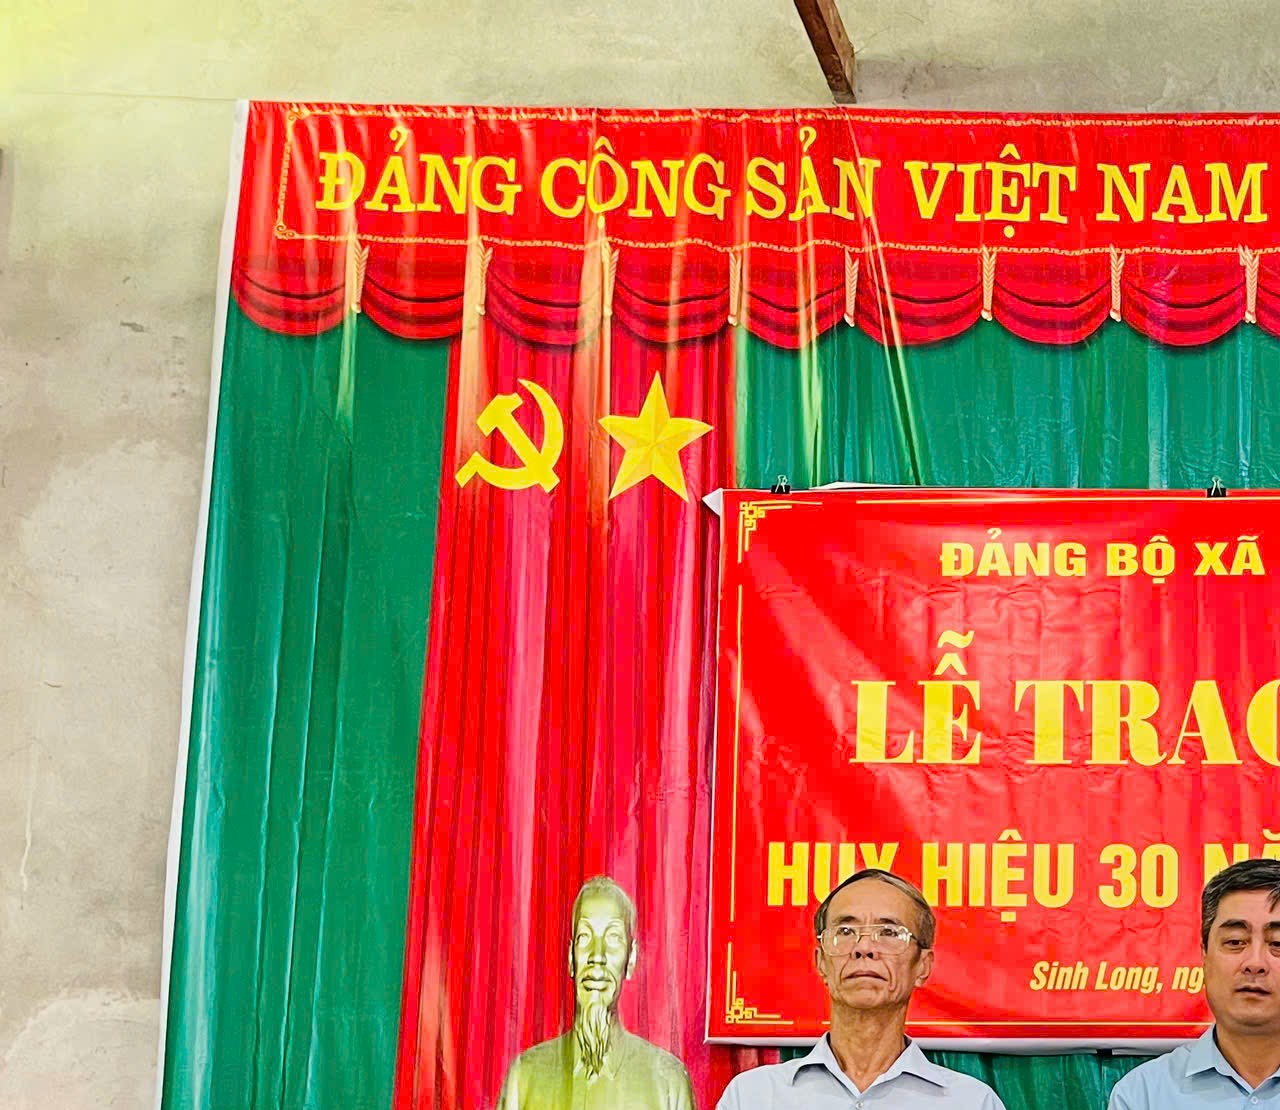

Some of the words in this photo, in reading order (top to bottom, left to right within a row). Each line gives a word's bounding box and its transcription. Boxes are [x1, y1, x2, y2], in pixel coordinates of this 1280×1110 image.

[316, 126, 522, 216] ĐẢNG
[541, 136, 731, 228] CỘNG
[746, 126, 881, 221] SẢN
[904, 144, 1076, 238] VIỆT
[1096, 162, 1268, 224] NAM
[940, 528, 1087, 577] ĐẢNG
[1106, 535, 1175, 584] BỘ
[1194, 535, 1264, 576] XÃ
[849, 630, 981, 766] LỄ
[922, 829, 1074, 922] HIỆU
[1098, 842, 1178, 908] 30
[1030, 960, 1089, 990] Sinh
[1095, 960, 1163, 994] Long,
